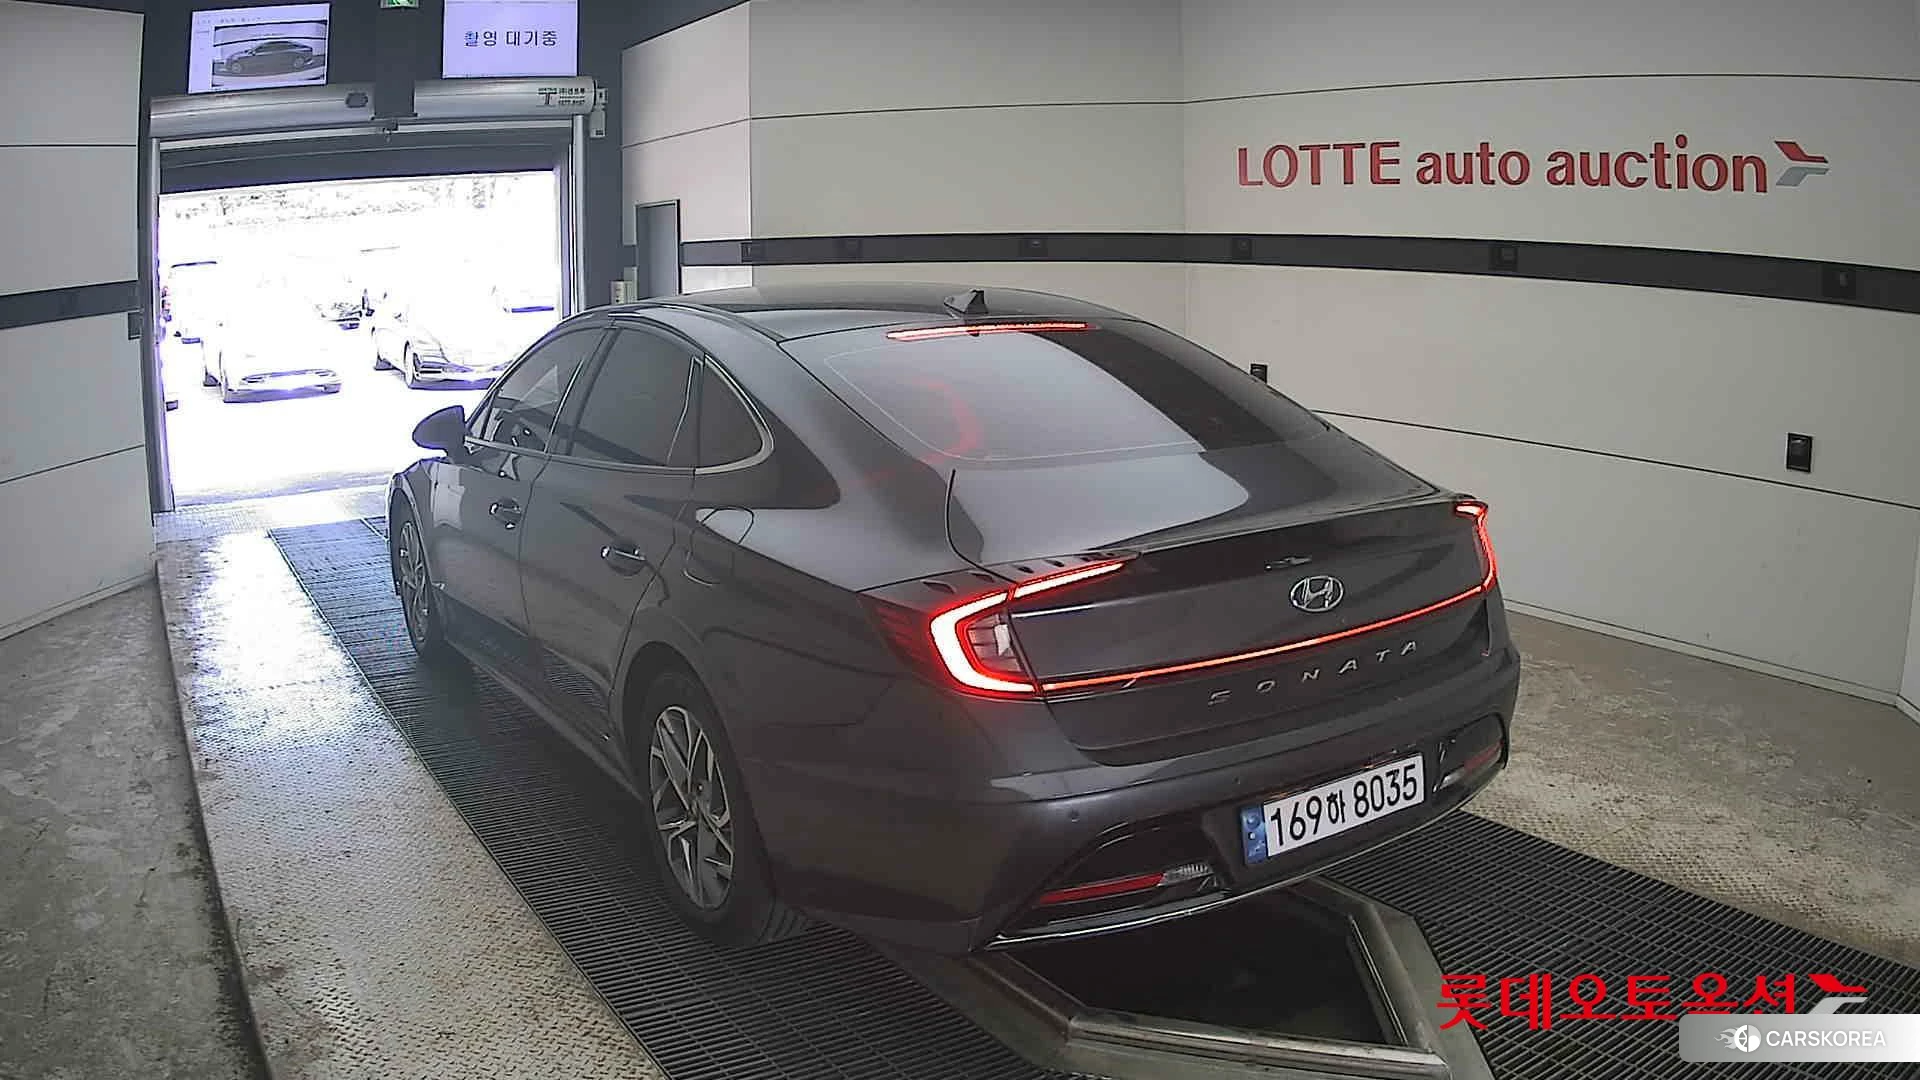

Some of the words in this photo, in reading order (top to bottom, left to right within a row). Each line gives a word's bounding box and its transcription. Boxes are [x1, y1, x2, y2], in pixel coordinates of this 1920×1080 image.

[506, 30, 558, 47] 대기중
[1237, 141, 1400, 188] LOTTE
[1416, 142, 1531, 186] auto
[1546, 134, 1768, 193] auction
[1208, 640, 1417, 705] SONATA
[1270, 789, 1346, 847] 169하
[1353, 763, 1418, 818] 8035
